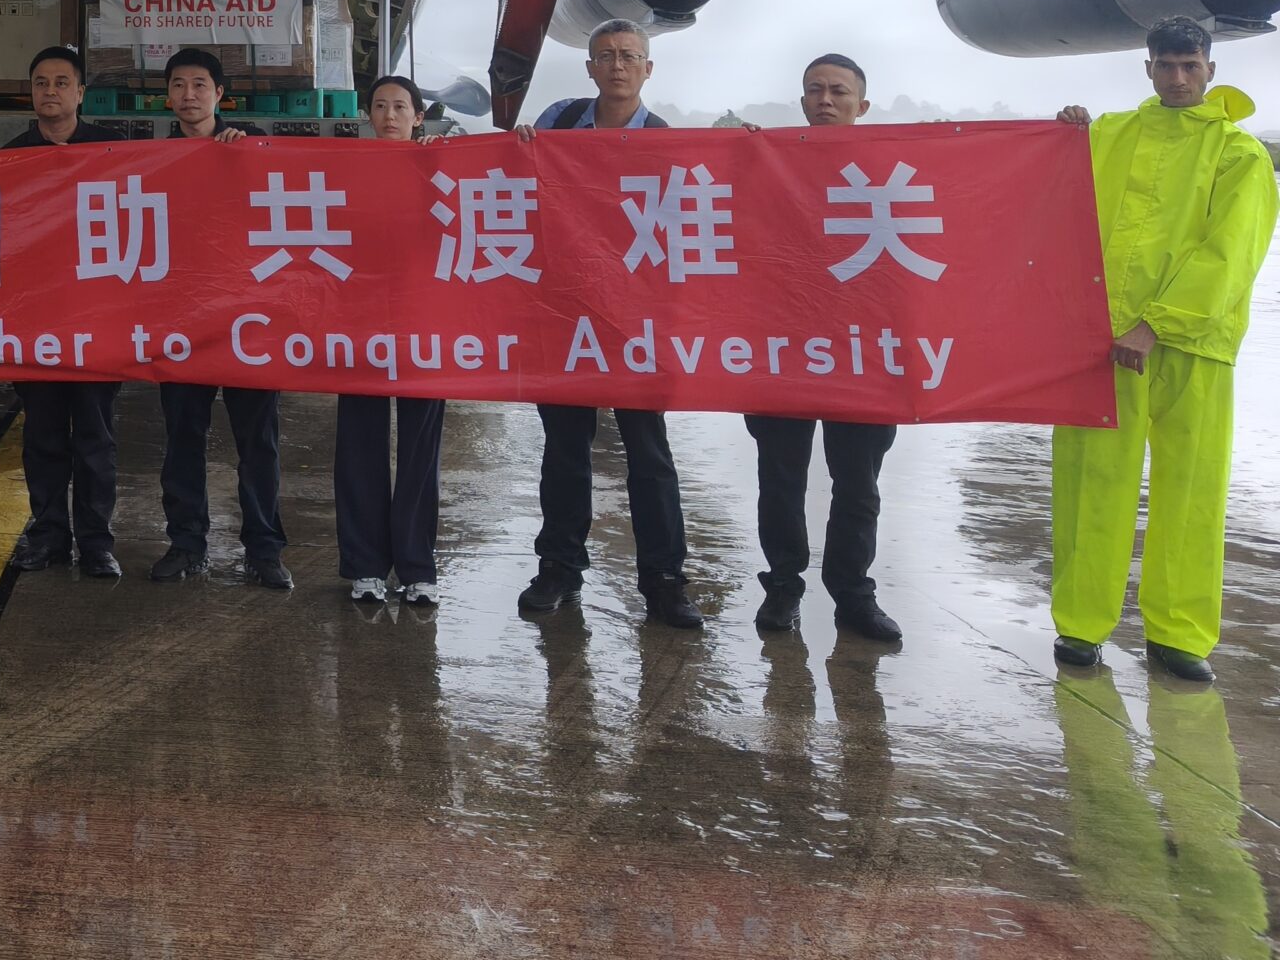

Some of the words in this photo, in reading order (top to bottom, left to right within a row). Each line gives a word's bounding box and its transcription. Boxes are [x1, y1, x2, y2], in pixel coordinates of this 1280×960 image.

[125, 16, 152, 28] FOR
[156, 15, 213, 28] SHARED
[218, 15, 274, 28] FUTURE
[135, 324, 192, 363] to
[231, 313, 519, 381] Conquer
[565, 315, 955, 390] Adversity
